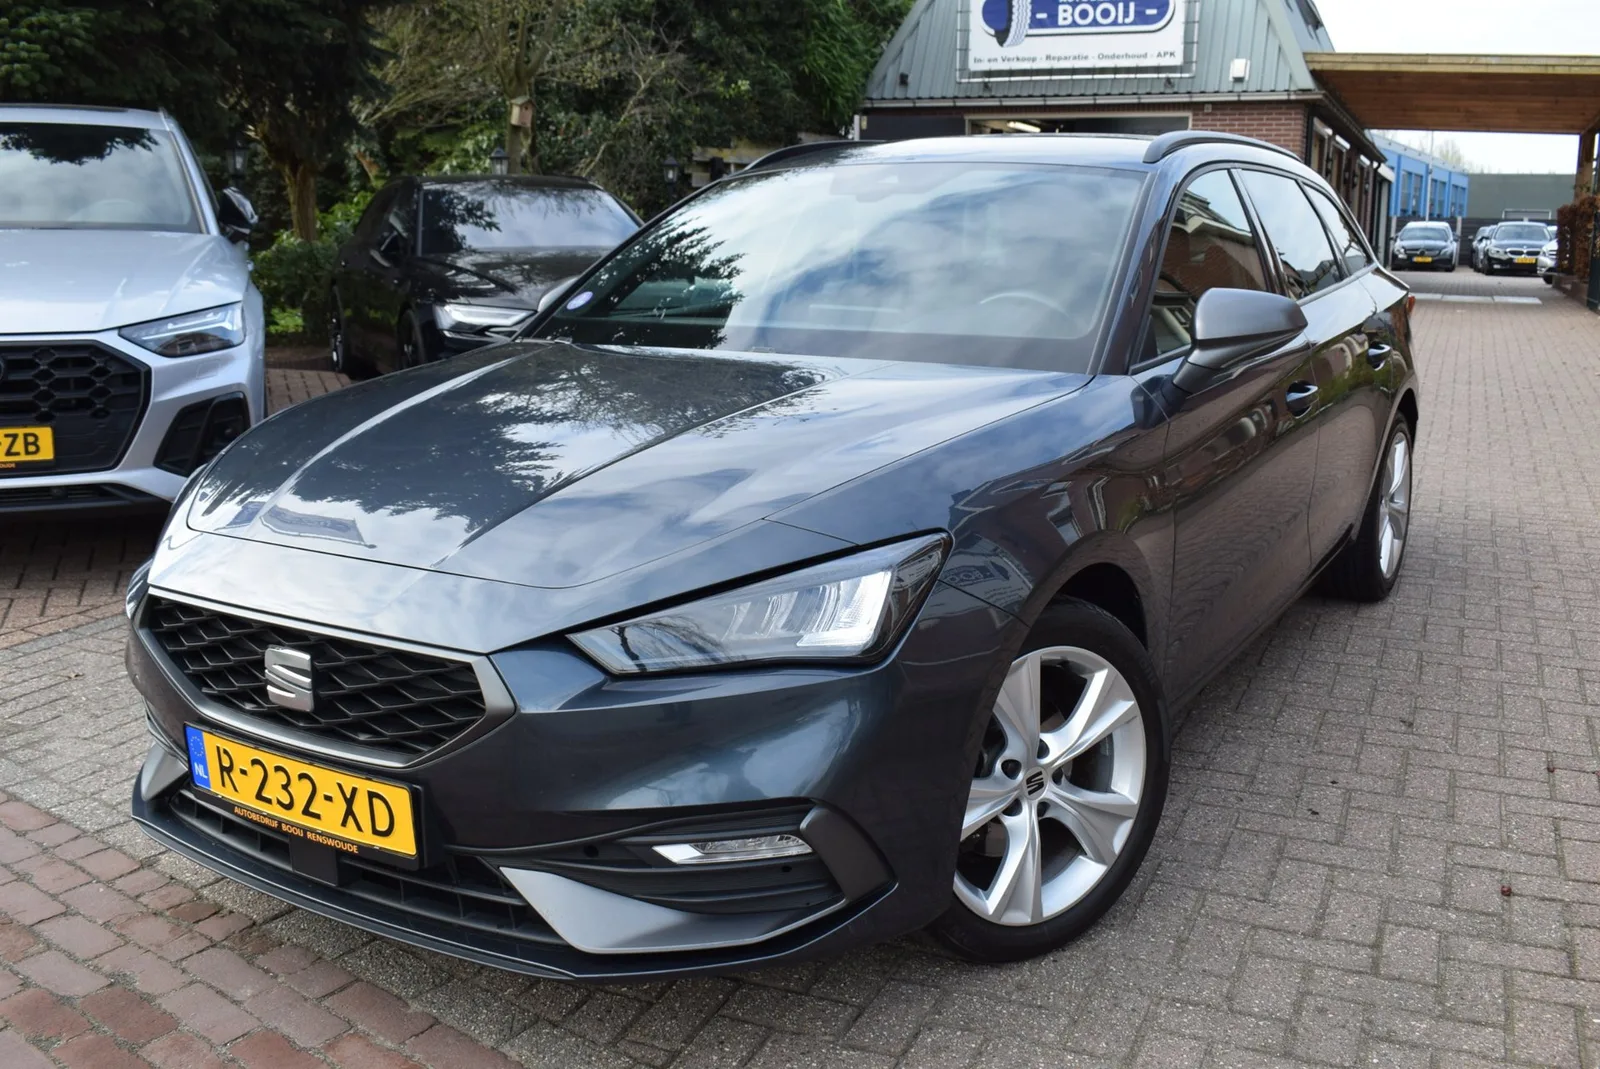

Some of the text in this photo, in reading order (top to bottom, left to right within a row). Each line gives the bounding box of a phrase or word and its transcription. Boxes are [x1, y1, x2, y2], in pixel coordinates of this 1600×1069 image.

[1057, 2, 1135, 26] BOOIJ
[1001, 55, 1037, 63] Verkoop
[1045, 54, 1089, 62] Reparatie
[1097, 52, 1148, 60] Onderhoud
[1156, 51, 1176, 59] APK
[0, 432, 40, 457] ZB
[194, 762, 208, 779] NL
[216, 745, 395, 838] R-232-XD
[234, 806, 359, 854] AUTOBEDRIJF BOOIJ RENSWOUDE
